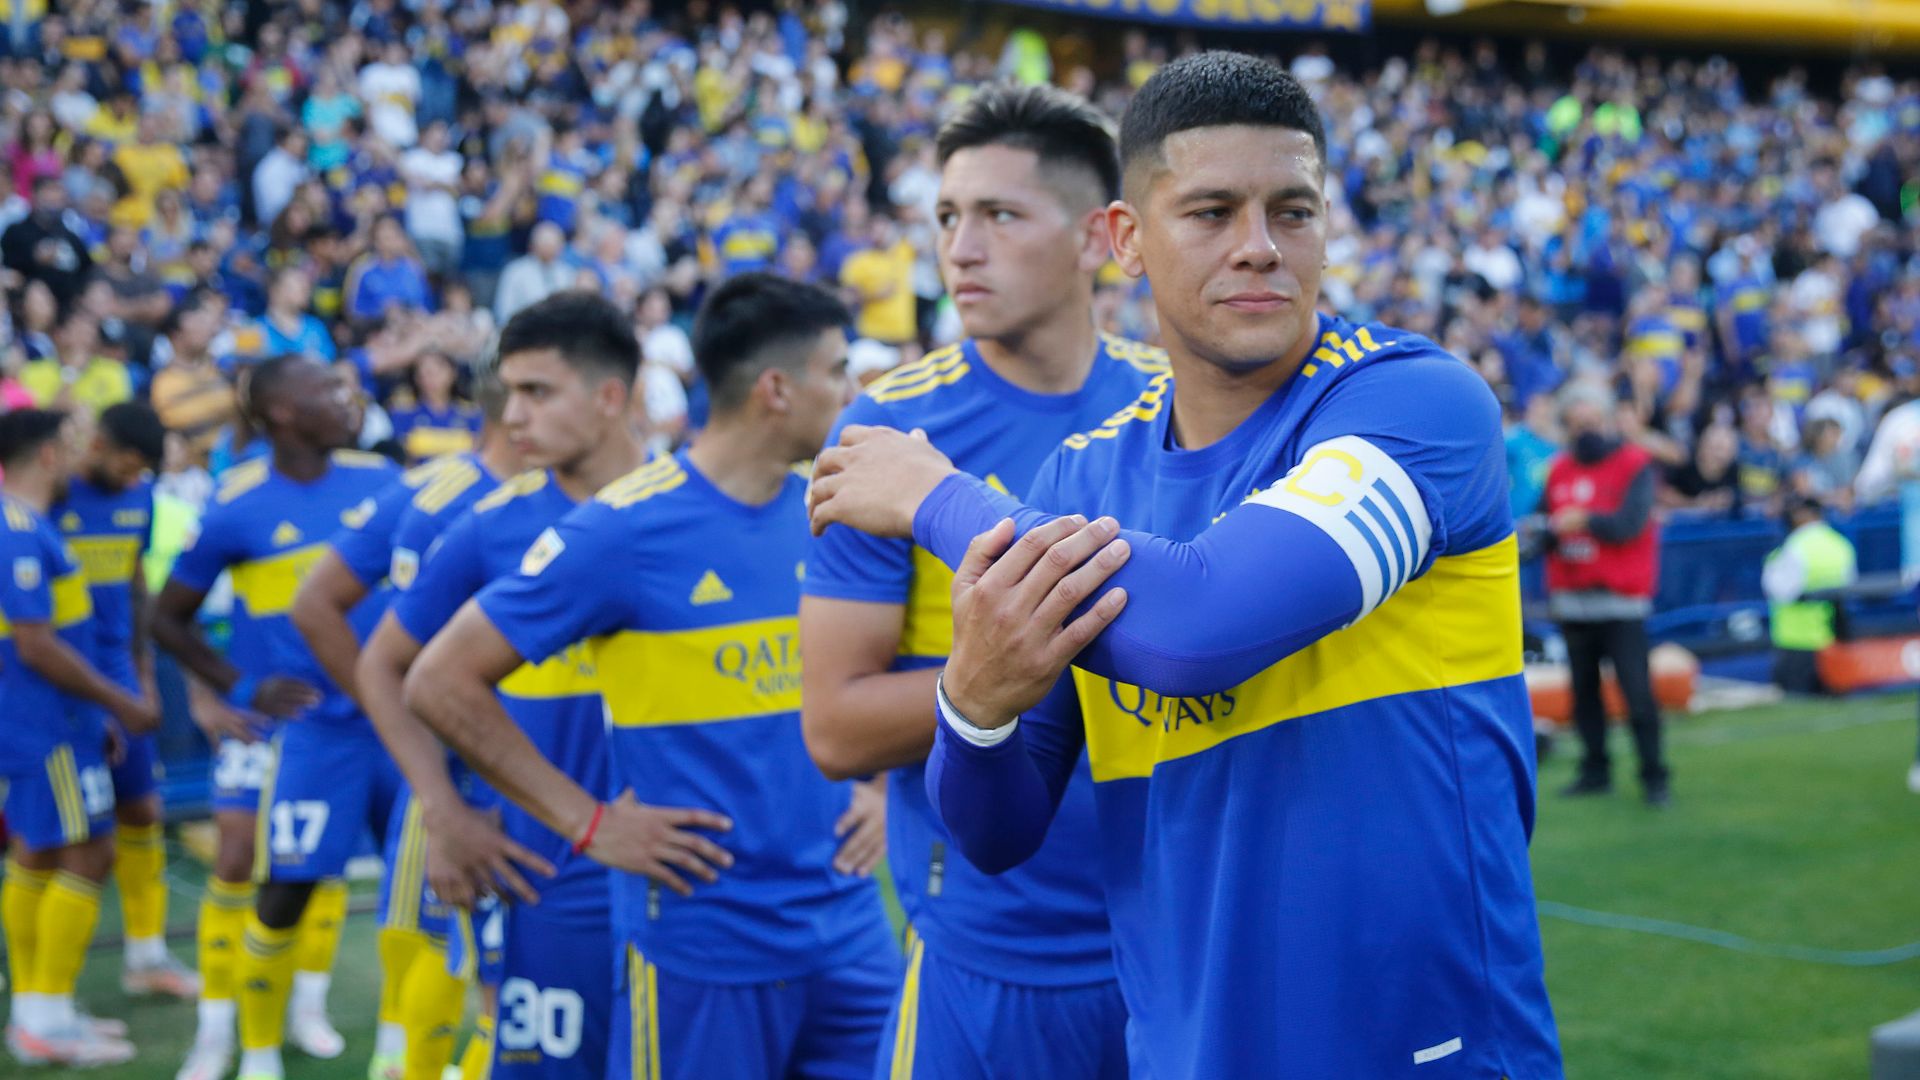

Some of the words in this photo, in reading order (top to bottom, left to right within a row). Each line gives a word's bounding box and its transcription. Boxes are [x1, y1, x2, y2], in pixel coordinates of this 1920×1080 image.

[1284, 449, 1363, 507] C
[714, 634, 801, 683] QAT
[271, 800, 330, 855] 17
[499, 976, 584, 1059] 30
